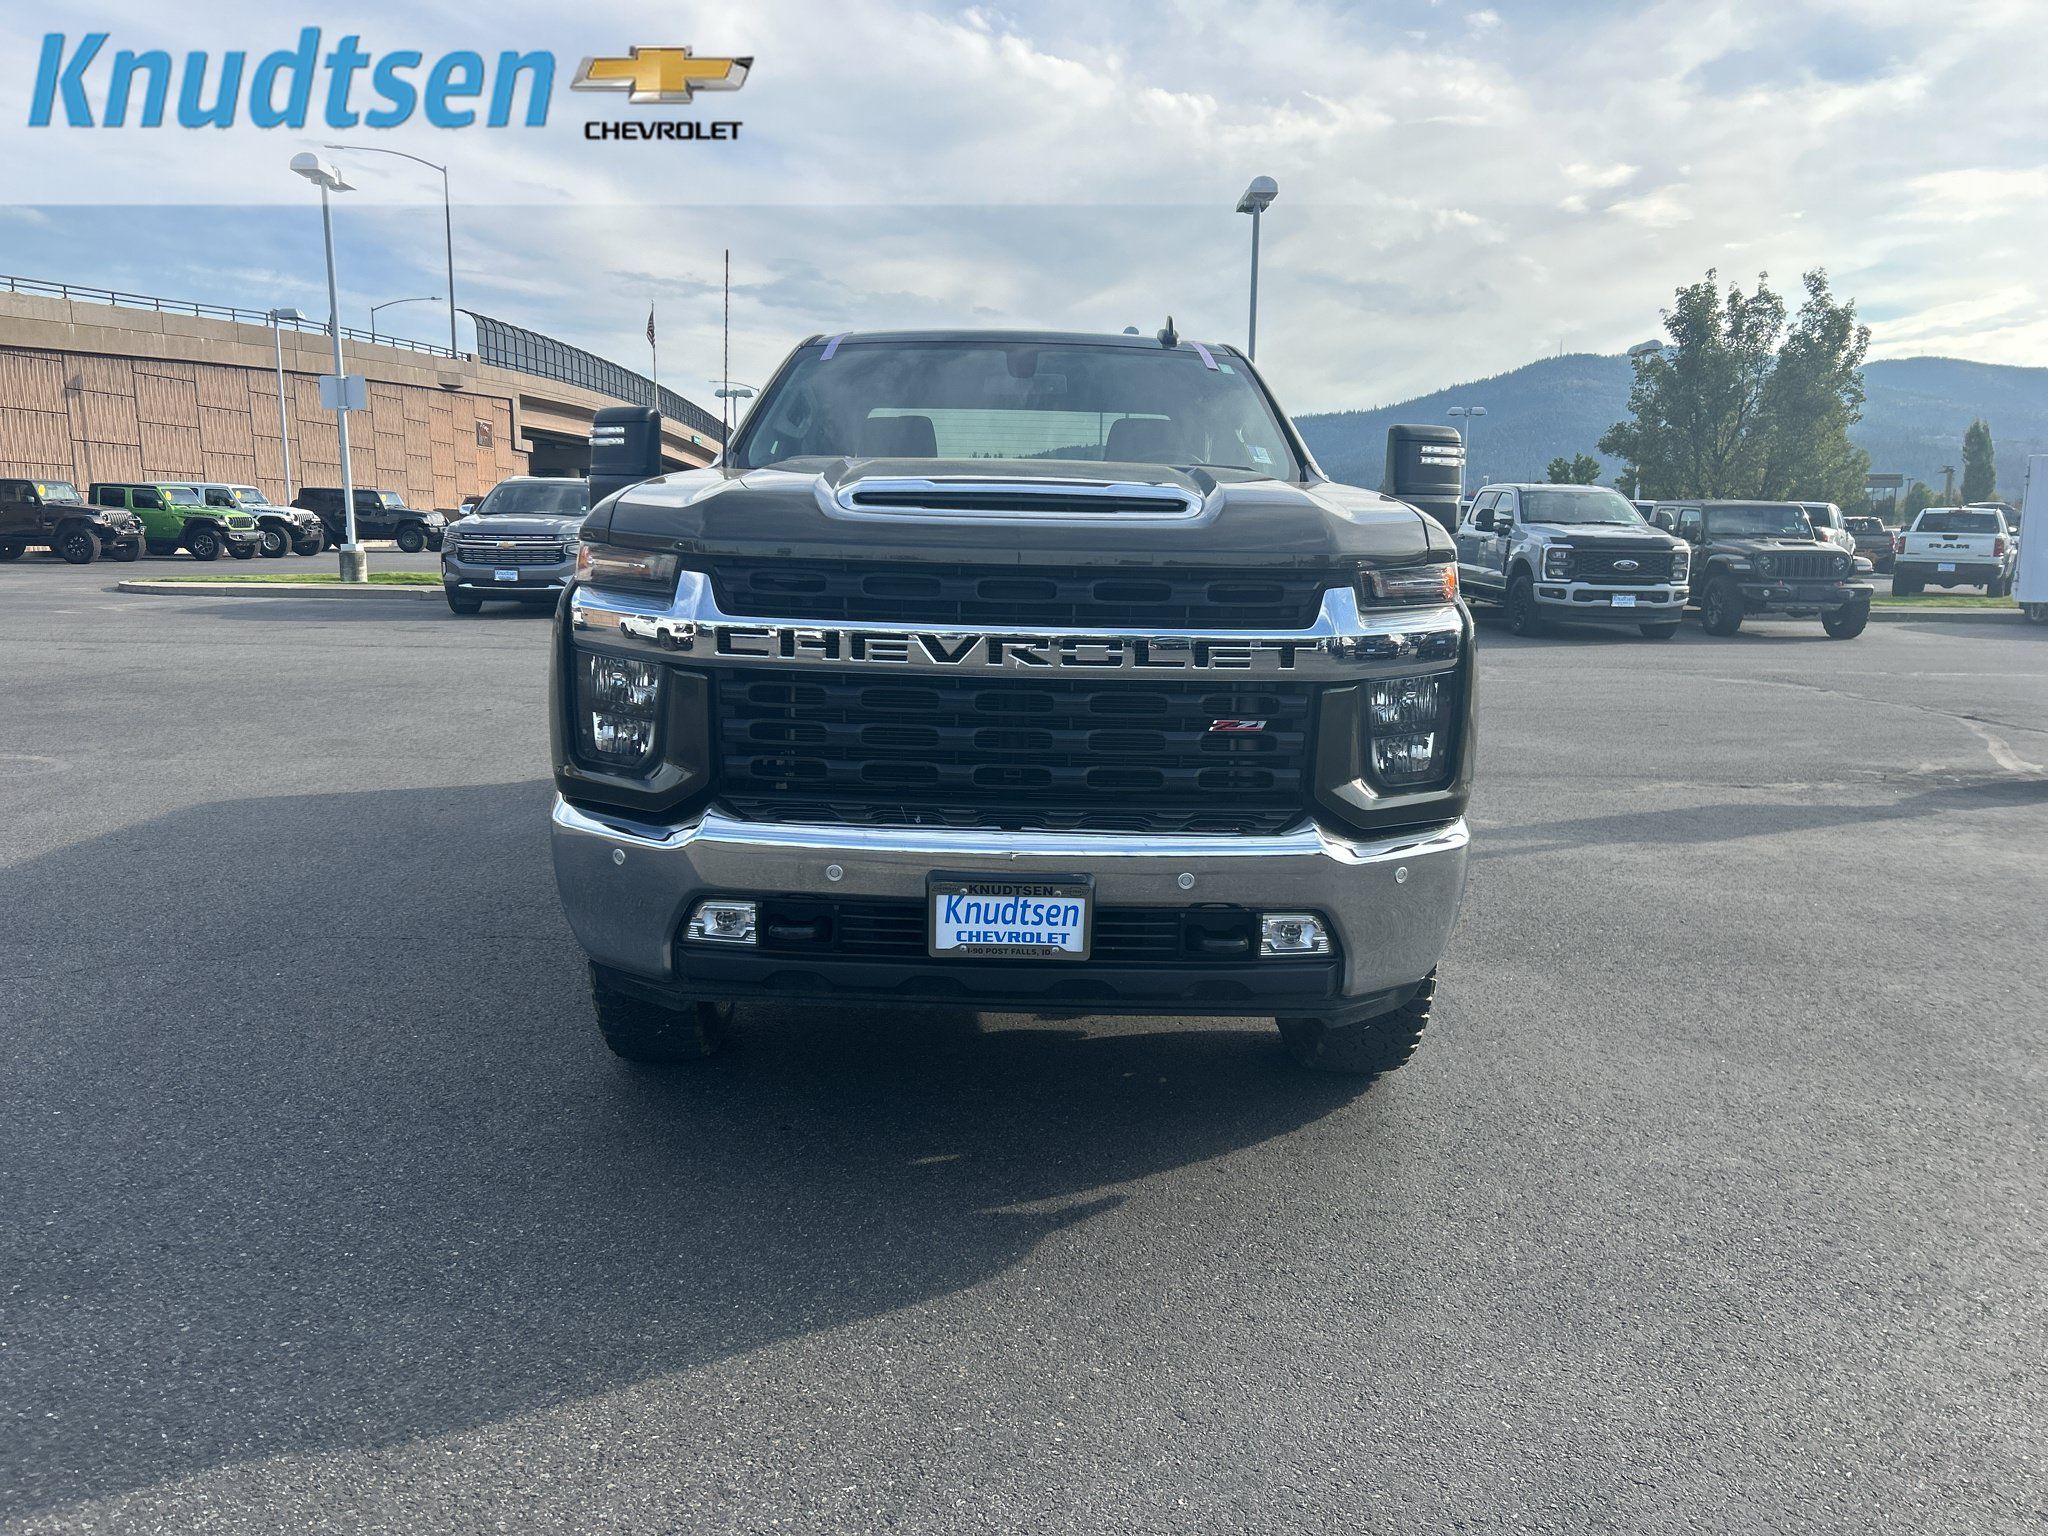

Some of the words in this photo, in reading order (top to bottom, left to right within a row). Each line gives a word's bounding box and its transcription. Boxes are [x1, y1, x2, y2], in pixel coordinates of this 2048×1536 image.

[715, 626, 1318, 670] CHEVROLET
[1208, 719, 1268, 732] Z71
[968, 884, 1054, 896] KNUDTSEN
[945, 895, 1080, 927] Knudtsen
[956, 930, 1071, 945] CHEVROLET
[985, 947, 1008, 955] POST
